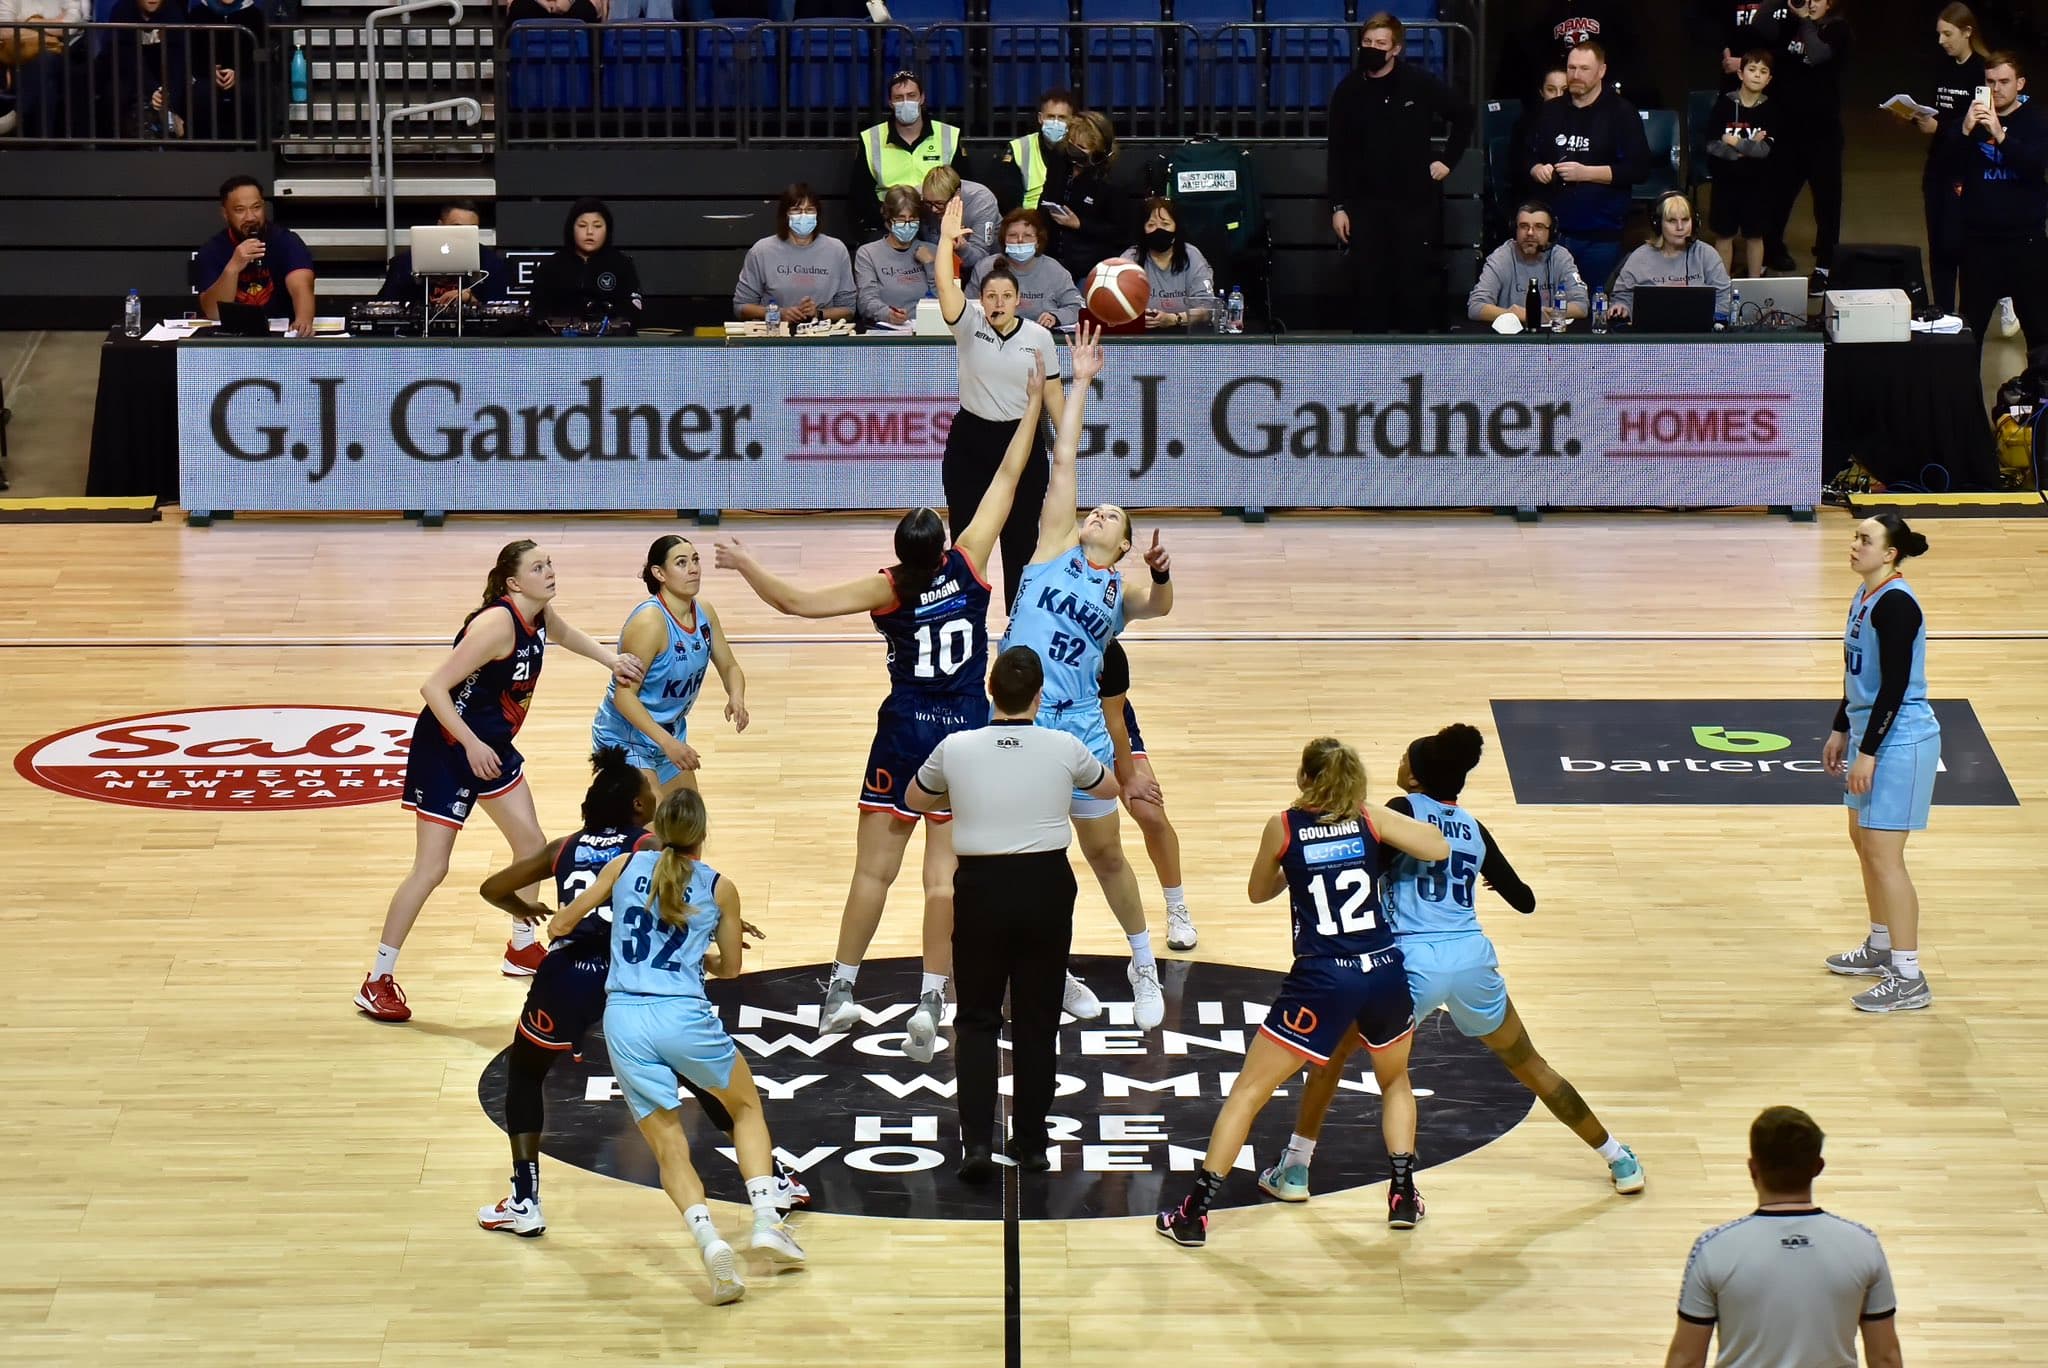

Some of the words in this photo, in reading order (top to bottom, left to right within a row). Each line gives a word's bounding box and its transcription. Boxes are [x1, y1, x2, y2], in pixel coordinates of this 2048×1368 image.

[1554, 17, 1600, 39] RAMS
[1182, 181, 1235, 190] AMBULANCE
[1190, 173, 1200, 181] ST
[1202, 172, 1225, 181] JOHN
[210, 376, 366, 482] G.J.
[388, 376, 763, 462] Gardner.
[1210, 374, 1582, 460] Gardner.
[1619, 410, 1779, 444] HOMES
[920, 579, 960, 605] BOAGNI
[914, 618, 974, 678] 10
[1049, 631, 1086, 667] 52
[512, 661, 530, 681] 21
[1559, 755, 1948, 773] barterc
[105, 780, 221, 788] NEW
[258, 779, 406, 788] YORK
[165, 789, 337, 799] PIZZA
[1299, 820, 1360, 842] GOULDING
[1427, 814, 1472, 842] GAYS
[1416, 850, 1478, 909] 35
[1307, 868, 1376, 936] 12
[622, 906, 689, 973] 32
[729, 1030, 1247, 1058] WOEN
[854, 1115, 1169, 1142] HRE
[715, 1144, 1257, 1173] WOEN
